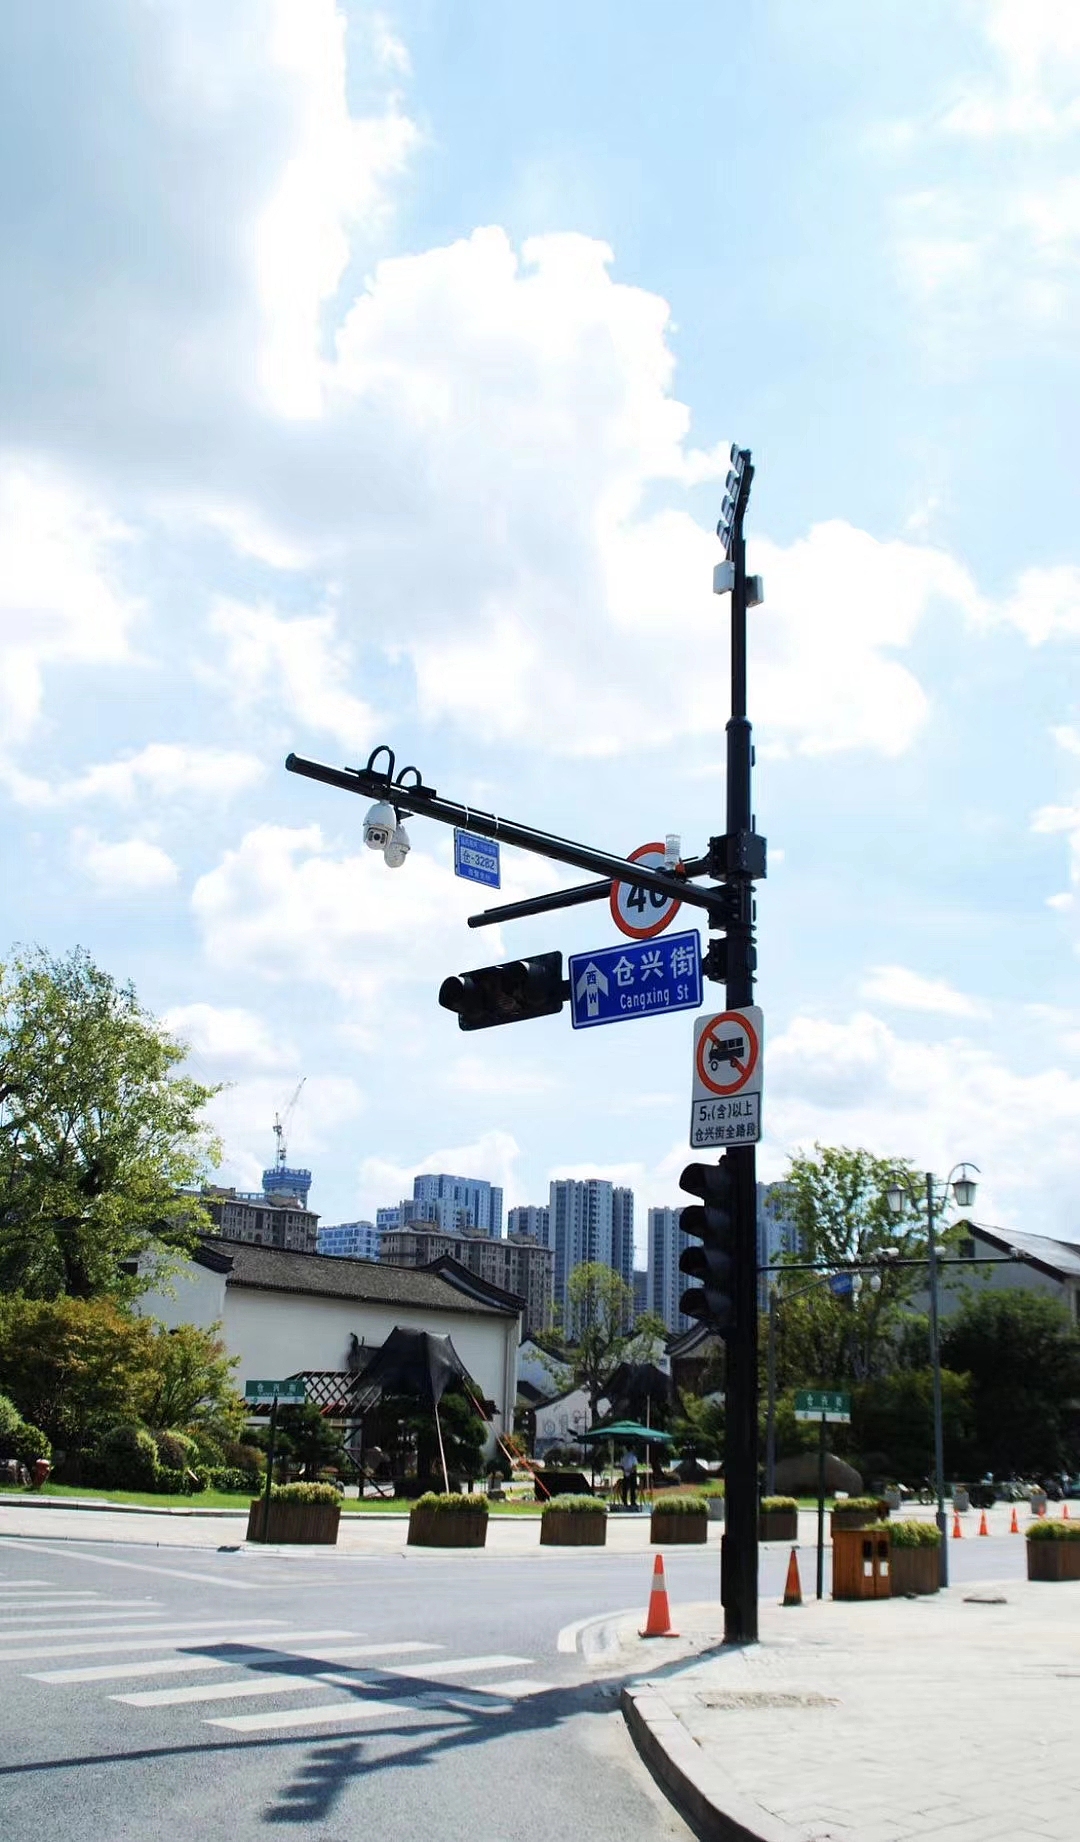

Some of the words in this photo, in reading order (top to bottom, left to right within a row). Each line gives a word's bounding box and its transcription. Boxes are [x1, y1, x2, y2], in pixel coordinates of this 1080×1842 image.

[612, 946, 696, 987] 仓兴街
[586, 971, 597, 985] 西
[588, 992, 598, 1004] W
[620, 987, 670, 1010] Cangxing
[677, 984, 689, 1001] St
[695, 1122, 756, 1142] 仓兴街全路段
